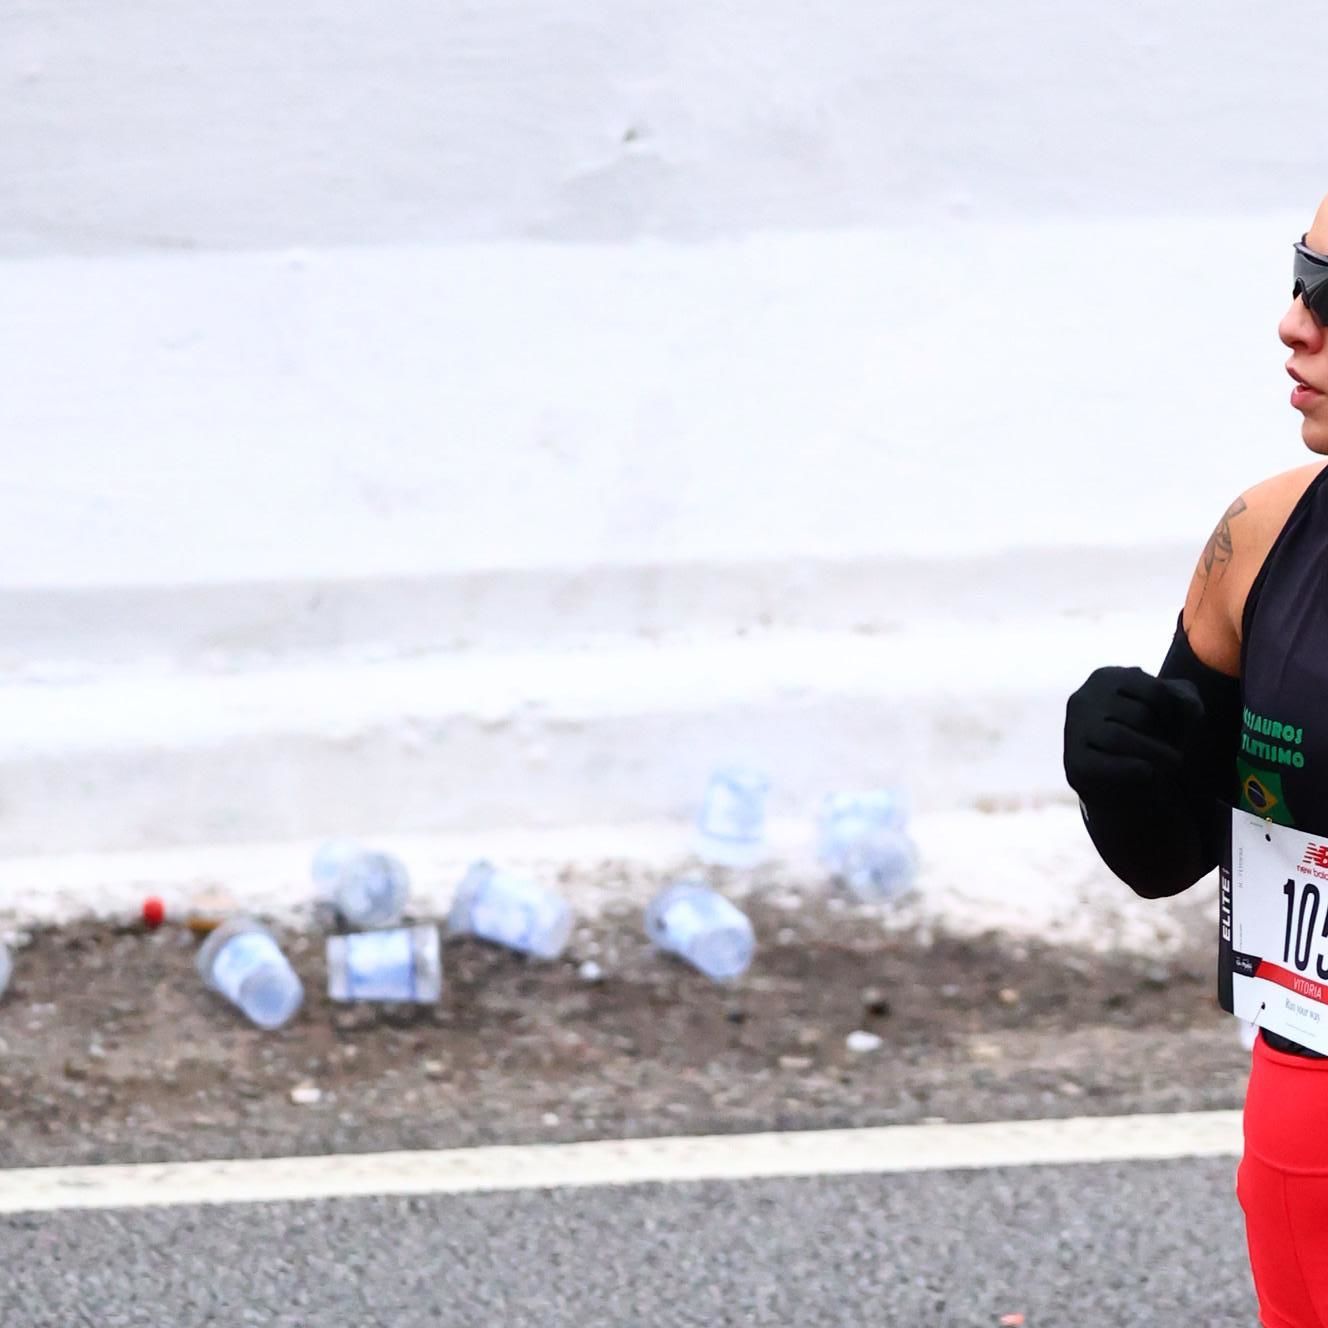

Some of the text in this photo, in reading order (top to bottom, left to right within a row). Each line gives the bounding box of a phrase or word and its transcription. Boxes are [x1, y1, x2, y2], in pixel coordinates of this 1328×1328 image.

[1296, 864, 1312, 875] new
[1222, 876, 1231, 942] ELITE
[1293, 976, 1322, 1000] VITORIA
